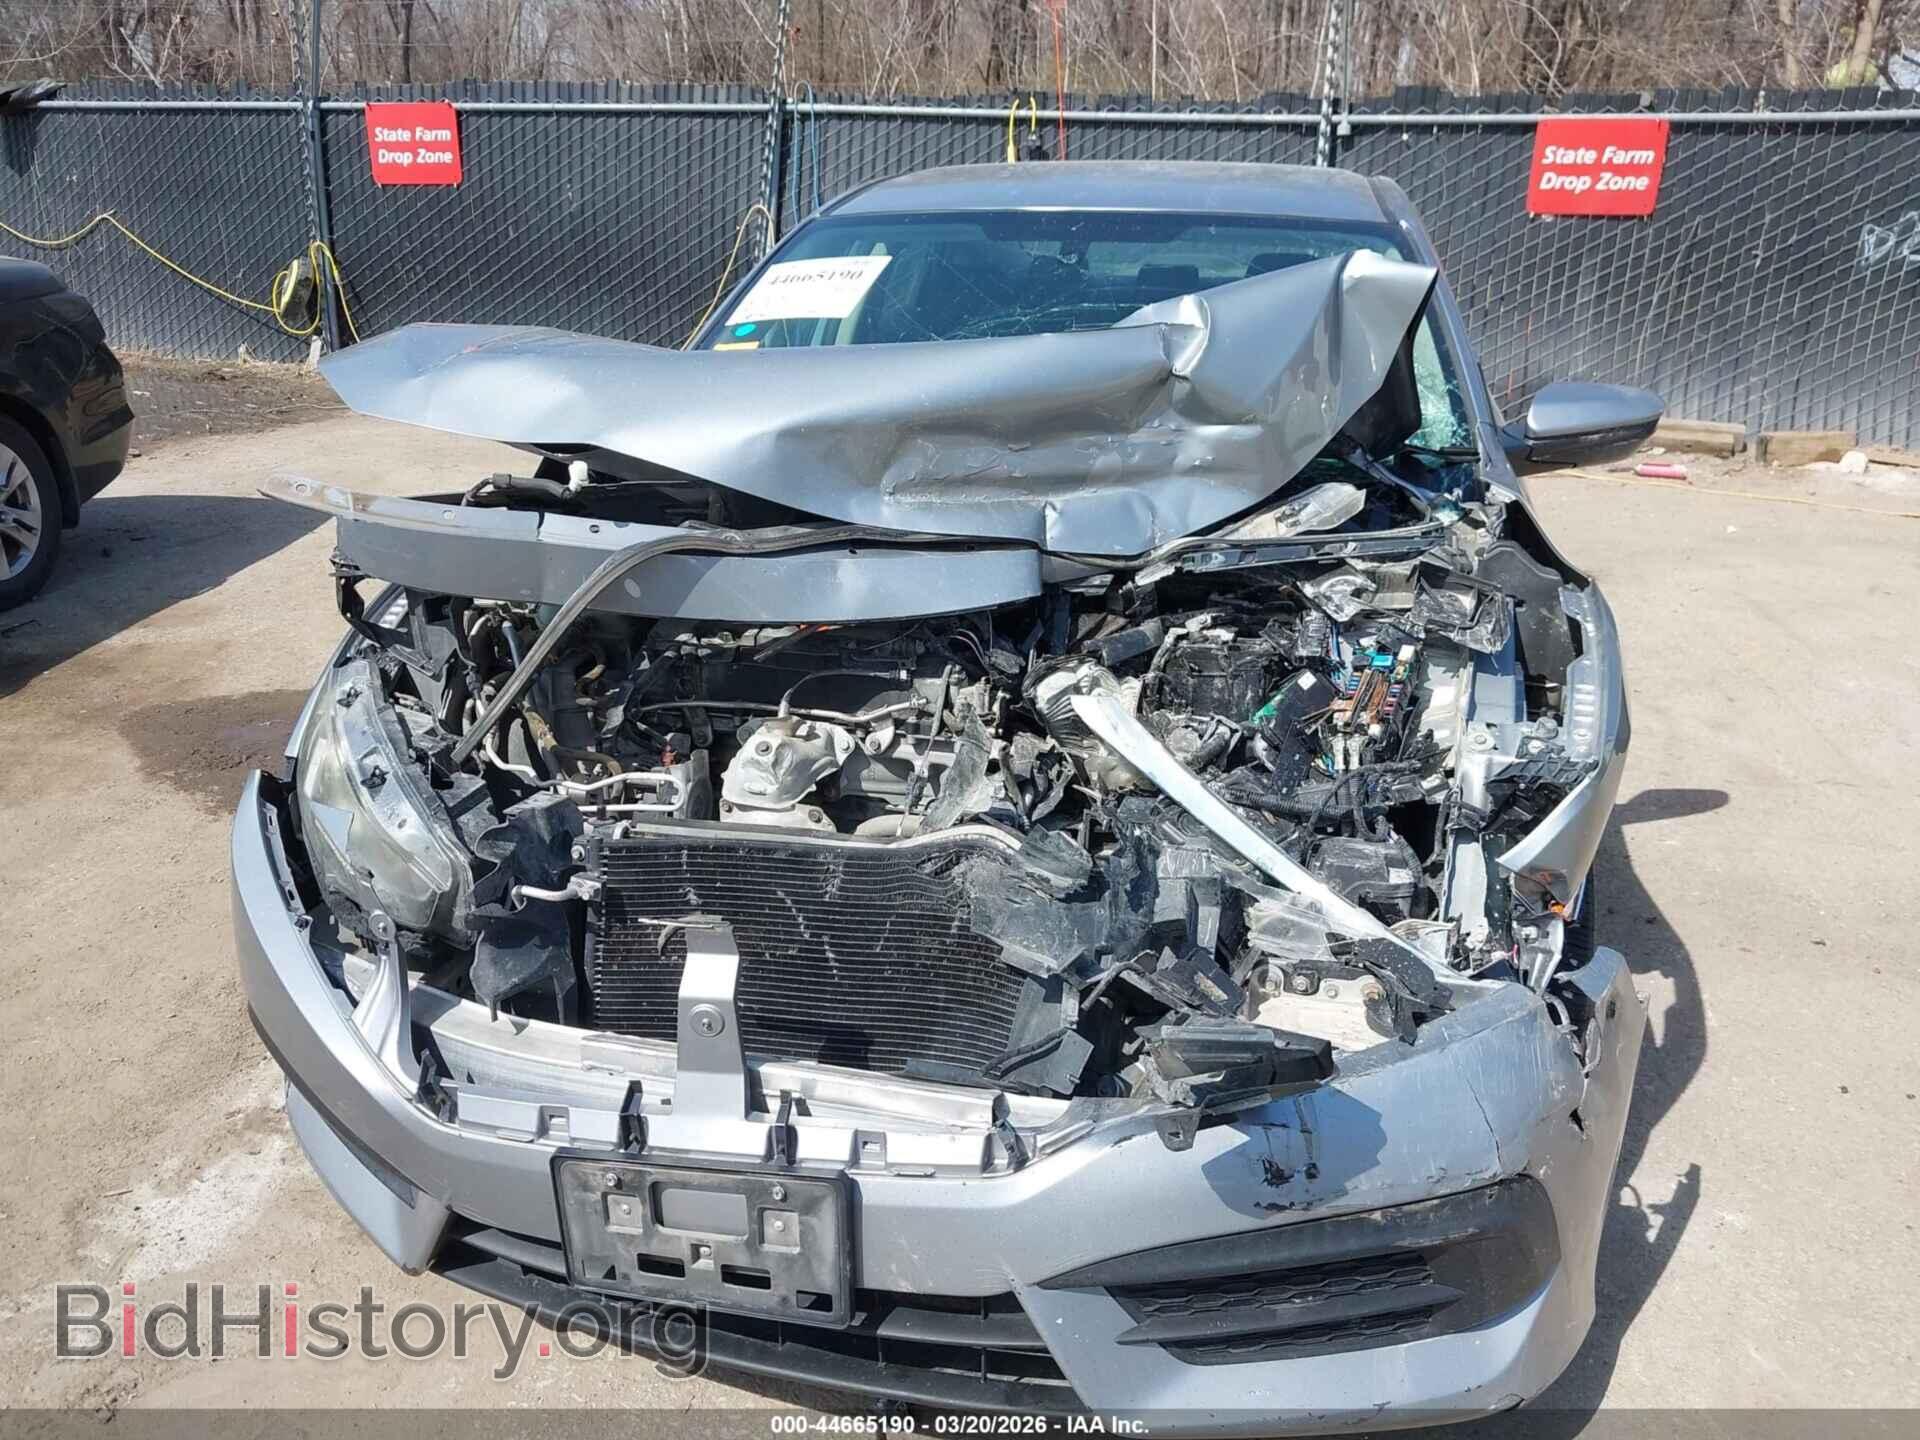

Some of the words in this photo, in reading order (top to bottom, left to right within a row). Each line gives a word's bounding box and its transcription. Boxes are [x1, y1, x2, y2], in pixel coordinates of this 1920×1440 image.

[374, 127, 412, 142] State
[415, 127, 451, 142] Farm
[378, 149, 413, 167] Drop
[416, 148, 453, 163] Zone
[1541, 145, 1597, 164] State
[1602, 146, 1655, 164] Farm
[1539, 171, 1592, 194] Drop
[1595, 172, 1649, 190] Zone
